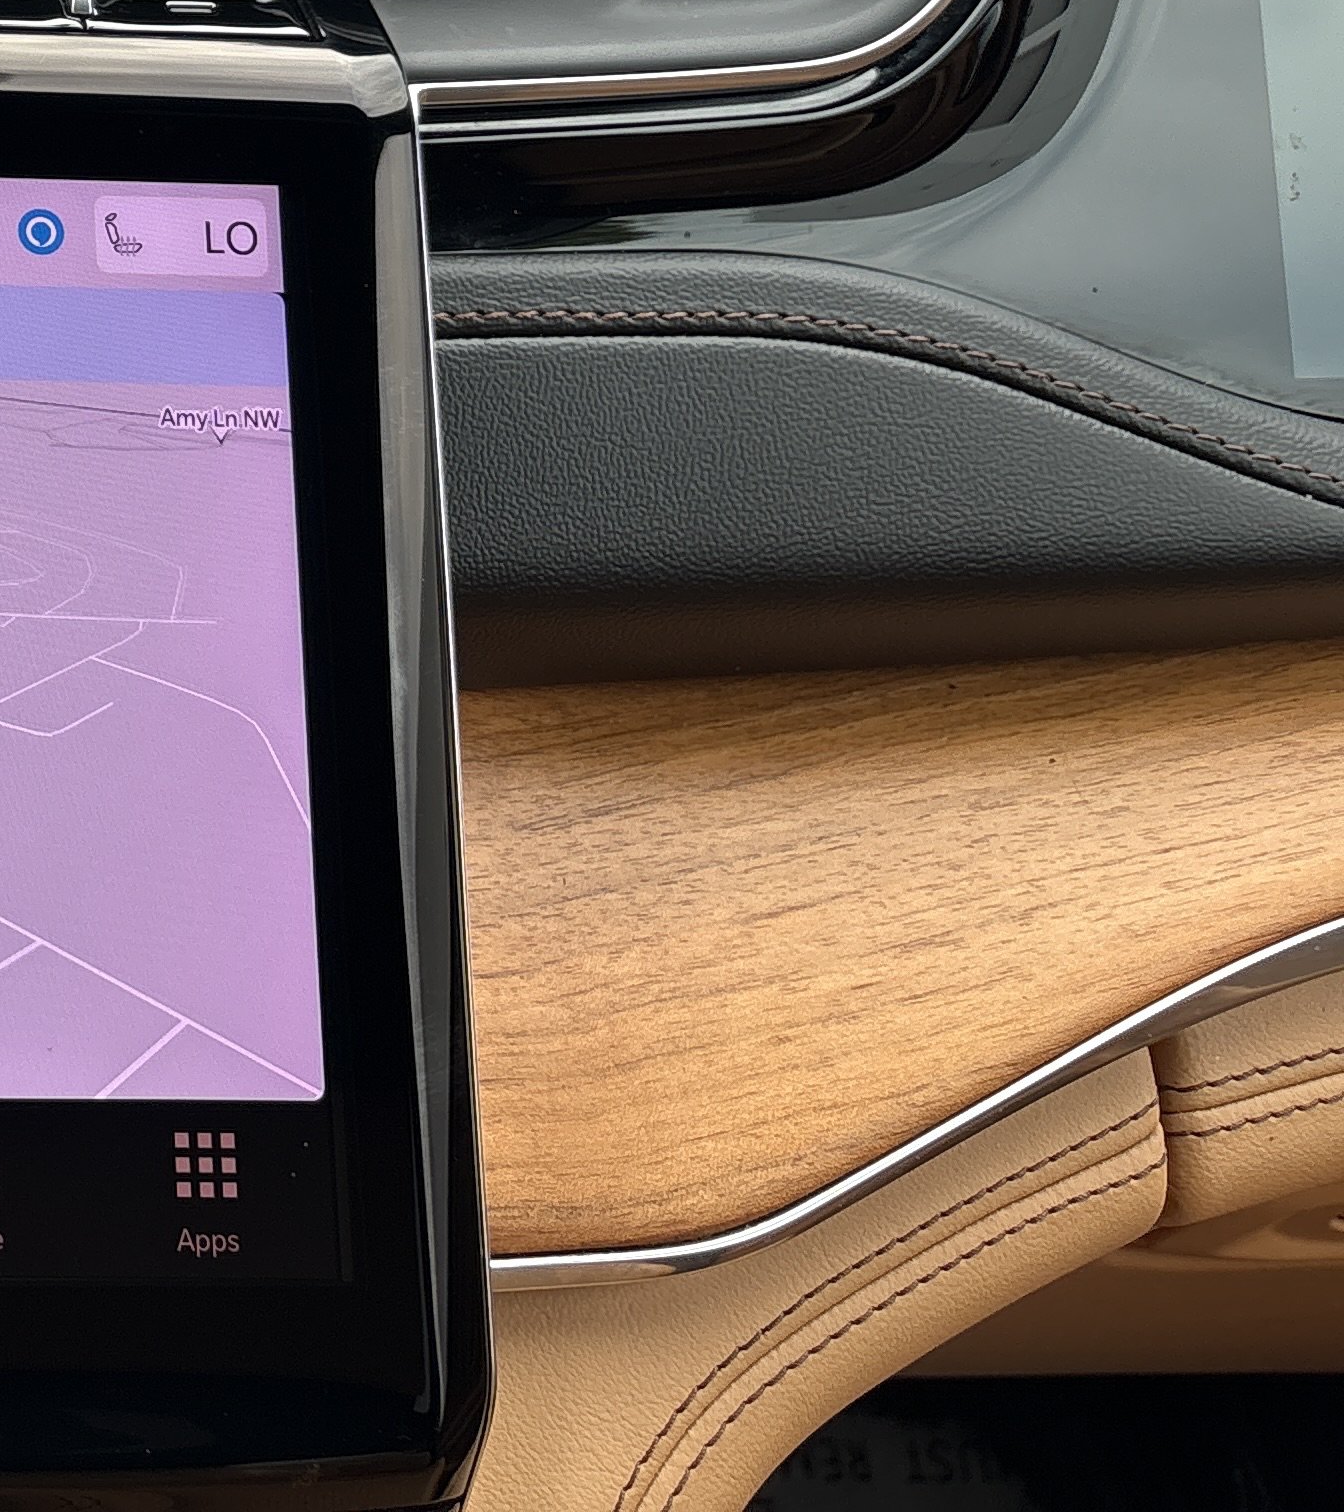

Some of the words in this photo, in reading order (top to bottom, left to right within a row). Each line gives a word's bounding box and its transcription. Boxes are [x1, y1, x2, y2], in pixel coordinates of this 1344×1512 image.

[205, 221, 258, 256] LO
[161, 408, 208, 431] Amy
[213, 409, 238, 428] Ln
[244, 409, 280, 428] NW
[177, 1228, 240, 1258] Apps
